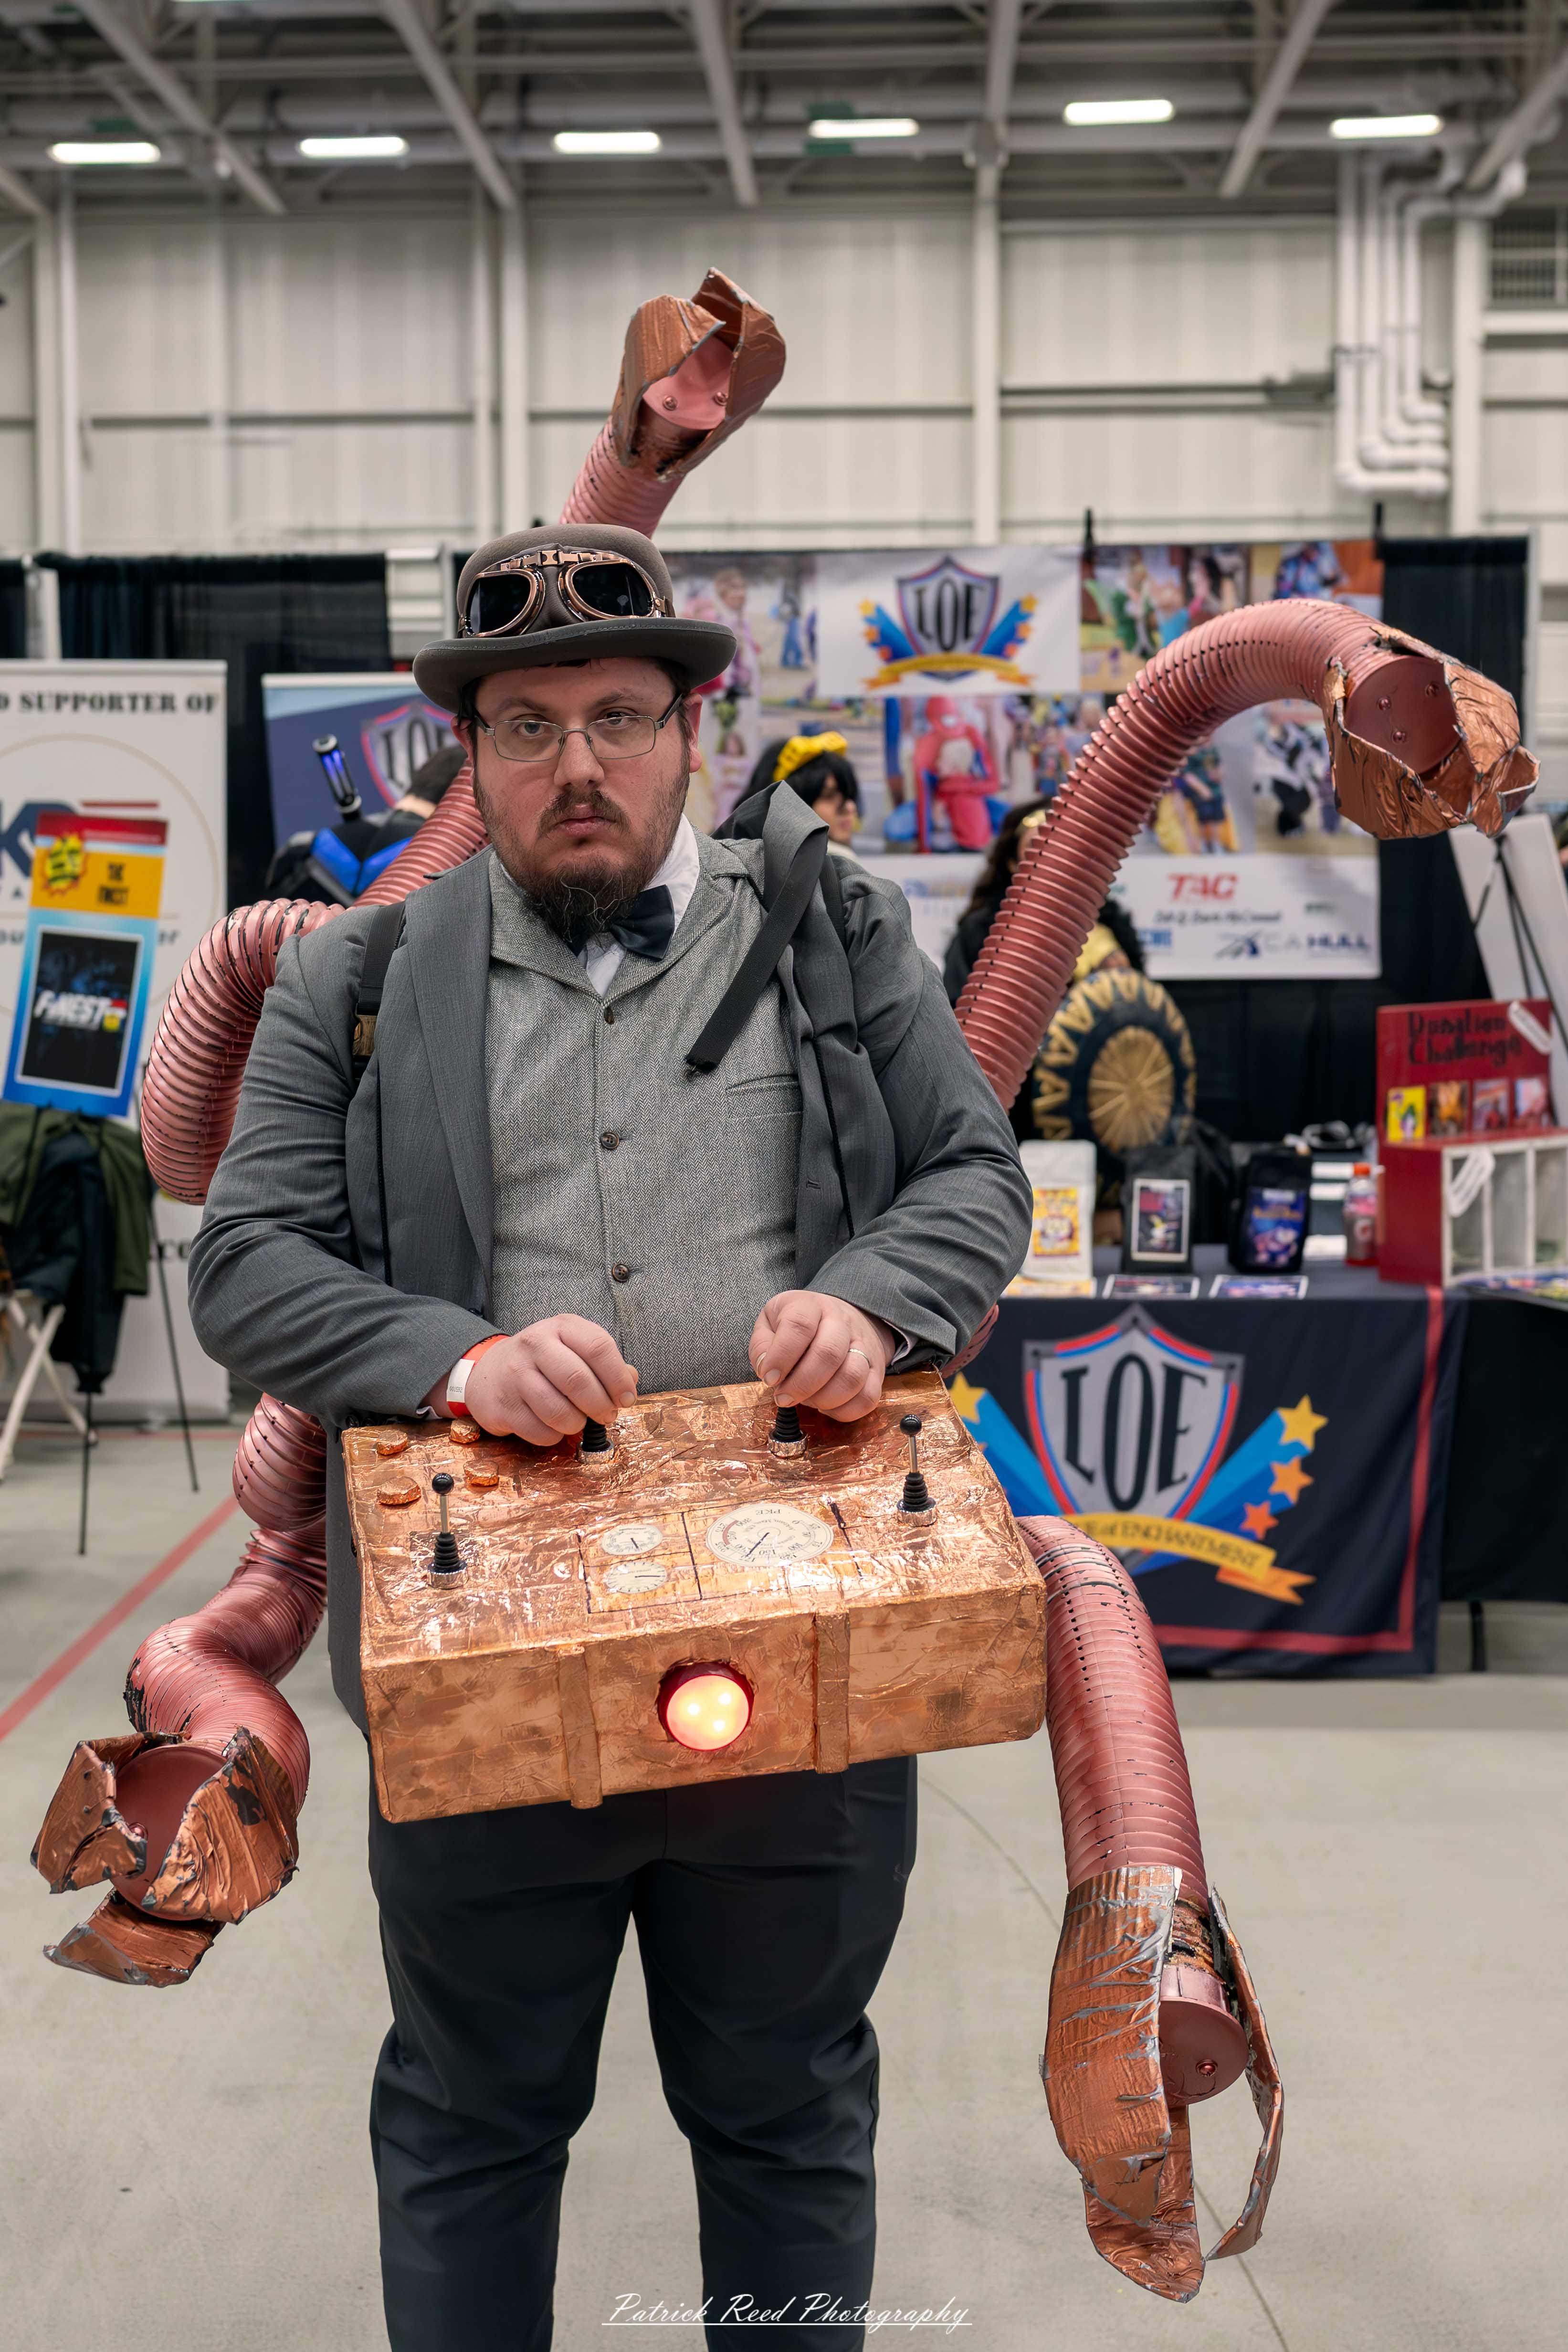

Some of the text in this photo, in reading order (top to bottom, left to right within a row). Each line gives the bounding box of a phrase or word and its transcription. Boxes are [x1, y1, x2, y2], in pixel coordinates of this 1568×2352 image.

[914, 577, 986, 654] LOE
[19, 692, 176, 712] SUPPORTER
[186, 692, 217, 712] OF
[1061, 1353, 1207, 1512] LOE
